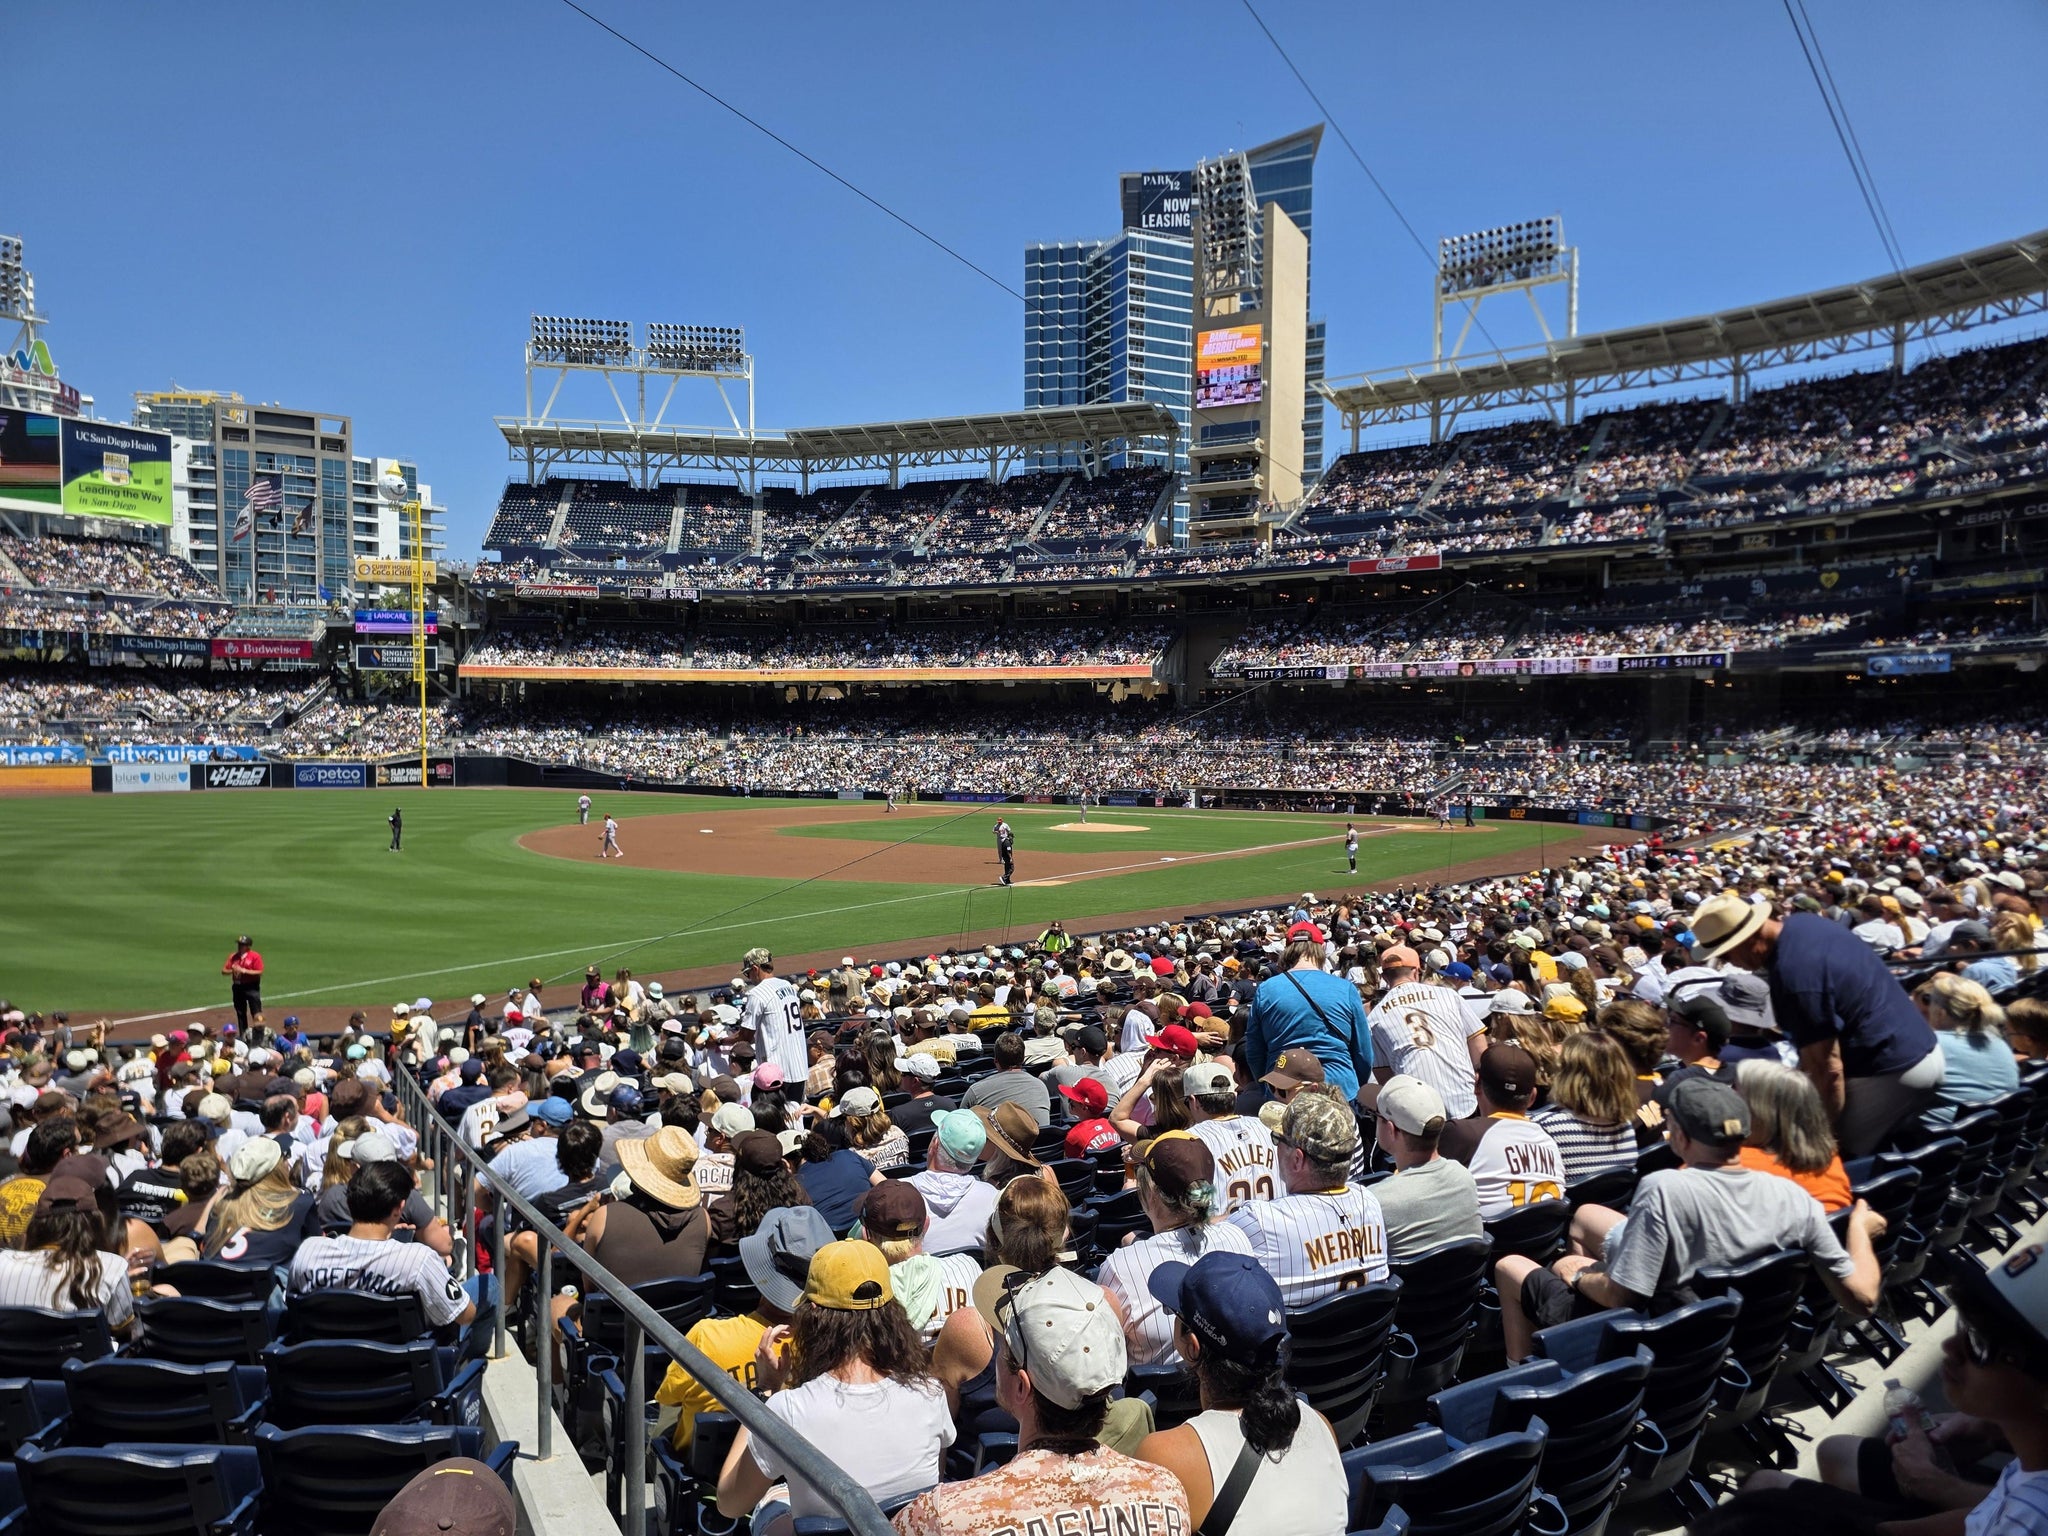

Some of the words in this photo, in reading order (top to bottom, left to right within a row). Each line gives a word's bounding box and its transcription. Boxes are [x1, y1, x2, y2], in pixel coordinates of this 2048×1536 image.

[1143, 175, 1171, 186] PARK
[1169, 180, 1181, 191] 12
[1163, 198, 1190, 213] NOW
[1142, 213, 1191, 228] LEASING
[76, 430, 90, 442] UC
[90, 433, 107, 445] San
[107, 436, 130, 449] Diego
[131, 440, 157, 453] Health
[78, 483, 121, 498] Leading
[122, 489, 139, 499] the
[141, 492, 163, 504] Way
[78, 496, 88, 505] in
[92, 498, 109, 508] San
[112, 500, 137, 511] Diego
[1956, 508, 2014, 526] JERRY
[1909, 564, 1919, 576] C
[517, 585, 562, 597] Tarantino
[563, 589, 598, 598] SAUSAGES
[669, 589, 698, 600] $14,550
[121, 637, 137, 648] UC
[137, 638, 154, 649] San
[154, 638, 178, 651] Diego
[178, 640, 206, 652] Health
[243, 643, 301, 655] Budweiser
[1621, 659, 1657, 669] SHIFT
[1674, 656, 1712, 667] SHIFT
[1248, 671, 1274, 679] SHIFT
[1288, 670, 1315, 678] SHIFT
[115, 771, 139, 783] blue
[154, 771, 177, 782] blue
[317, 767, 361, 783] petco
[1587, 815, 1606, 825] COX
[1381, 990, 1436, 1014] MERRILL
[783, 1001, 803, 1034] 19
[1404, 1012, 1435, 1047] 3
[1217, 1143, 1275, 1177] MILLER
[1504, 1143, 1556, 1177] GWYNN
[1304, 1224, 1383, 1271] MERRILL
[303, 1267, 402, 1294] HOFFMAN
